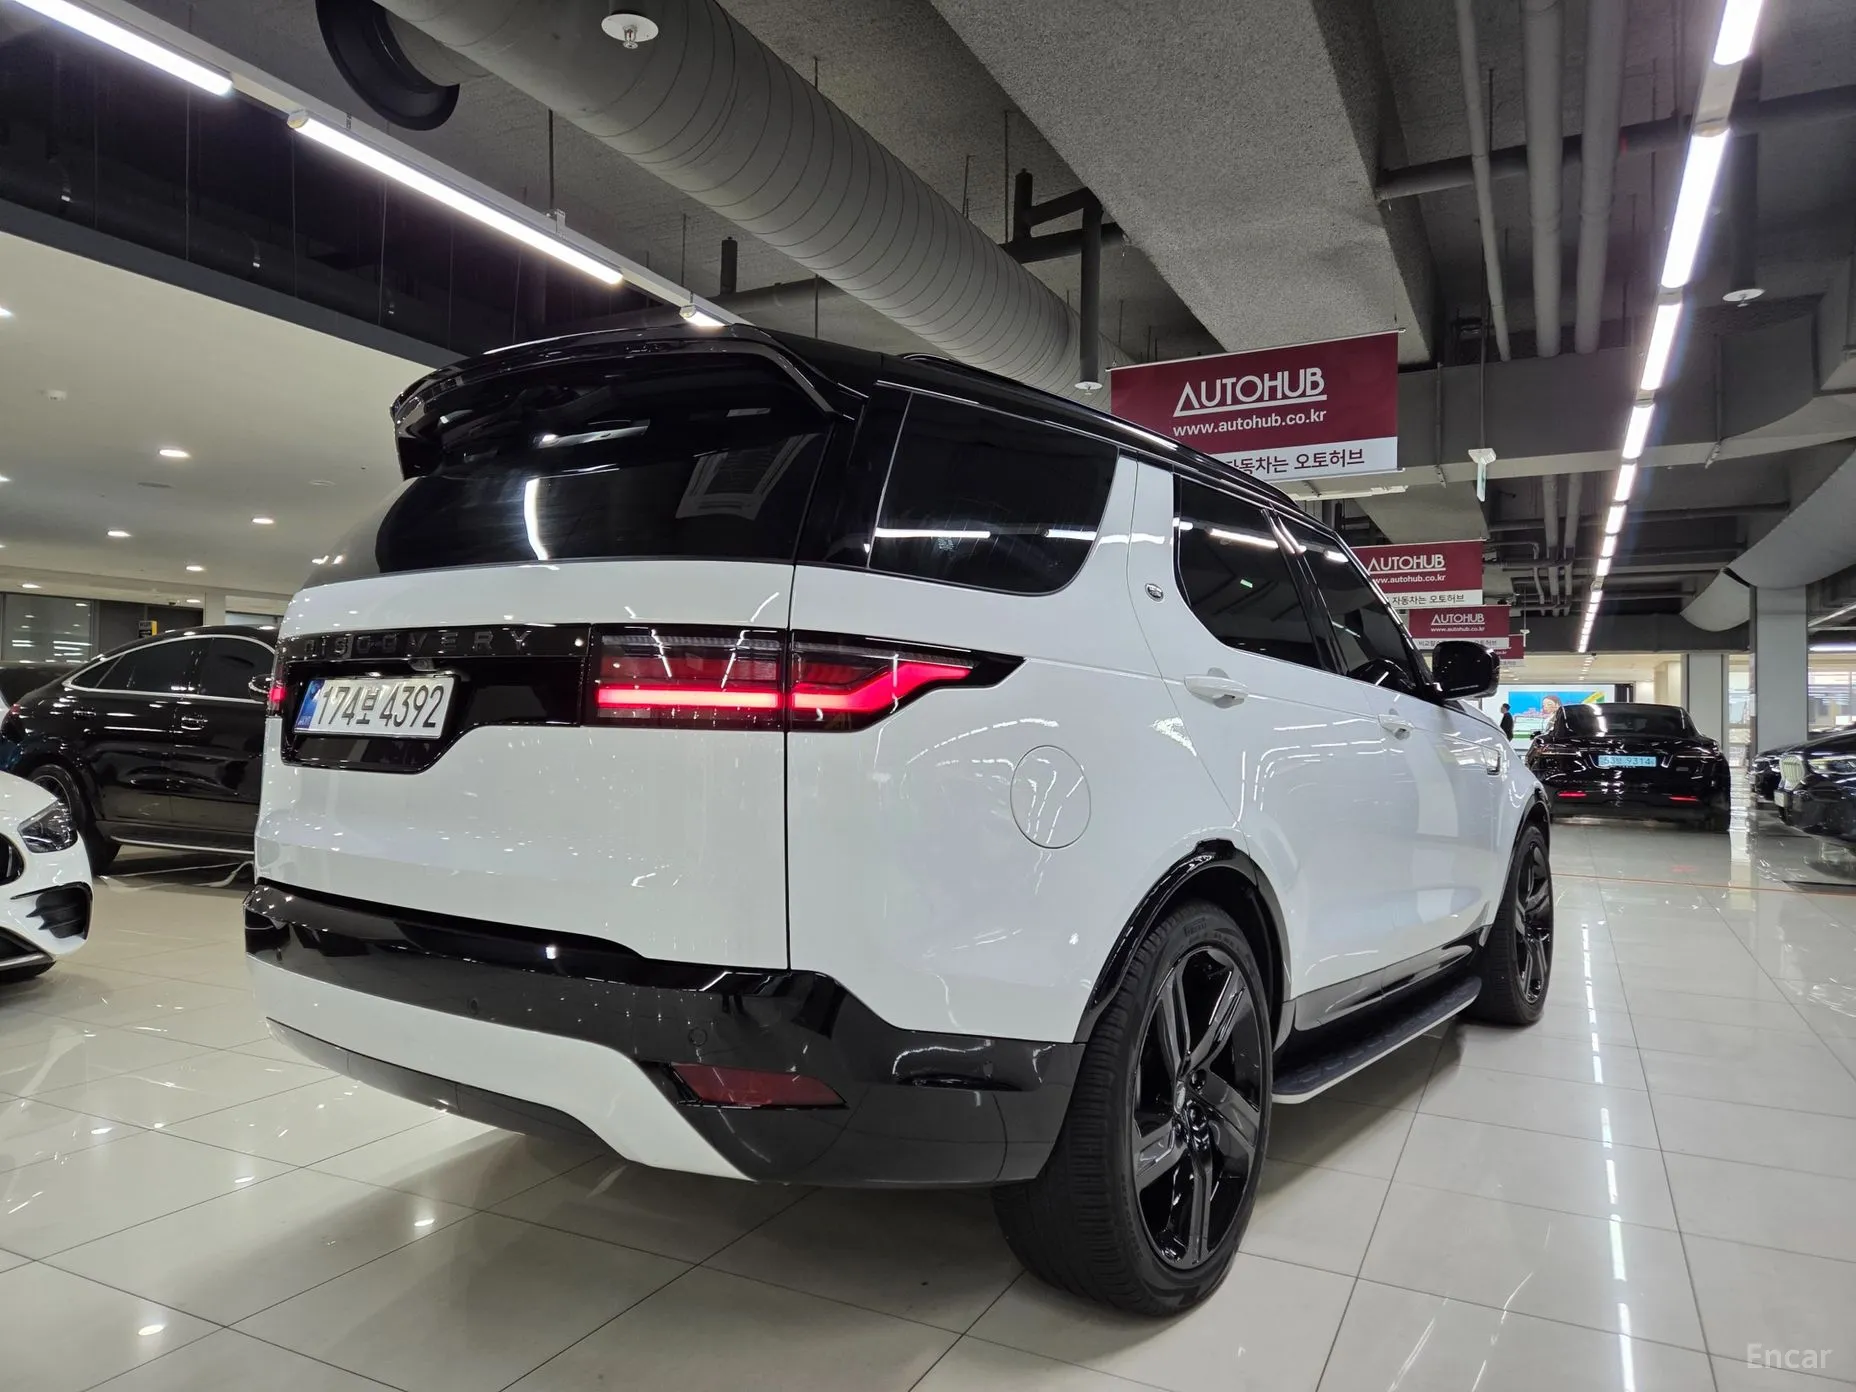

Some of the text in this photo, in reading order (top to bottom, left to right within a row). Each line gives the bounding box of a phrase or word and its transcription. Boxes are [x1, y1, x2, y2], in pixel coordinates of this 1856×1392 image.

[1173, 367, 1327, 417] AUTOHUB
[1173, 409, 1327, 436] www.autohub.co.kr
[1294, 448, 1364, 469] 오토허브
[1368, 554, 1446, 574] AUTOHUB
[1392, 594, 1465, 605] 자동차는 오토허브
[1431, 613, 1485, 625] AUTOHUB
[379, 685, 444, 728] 4392
